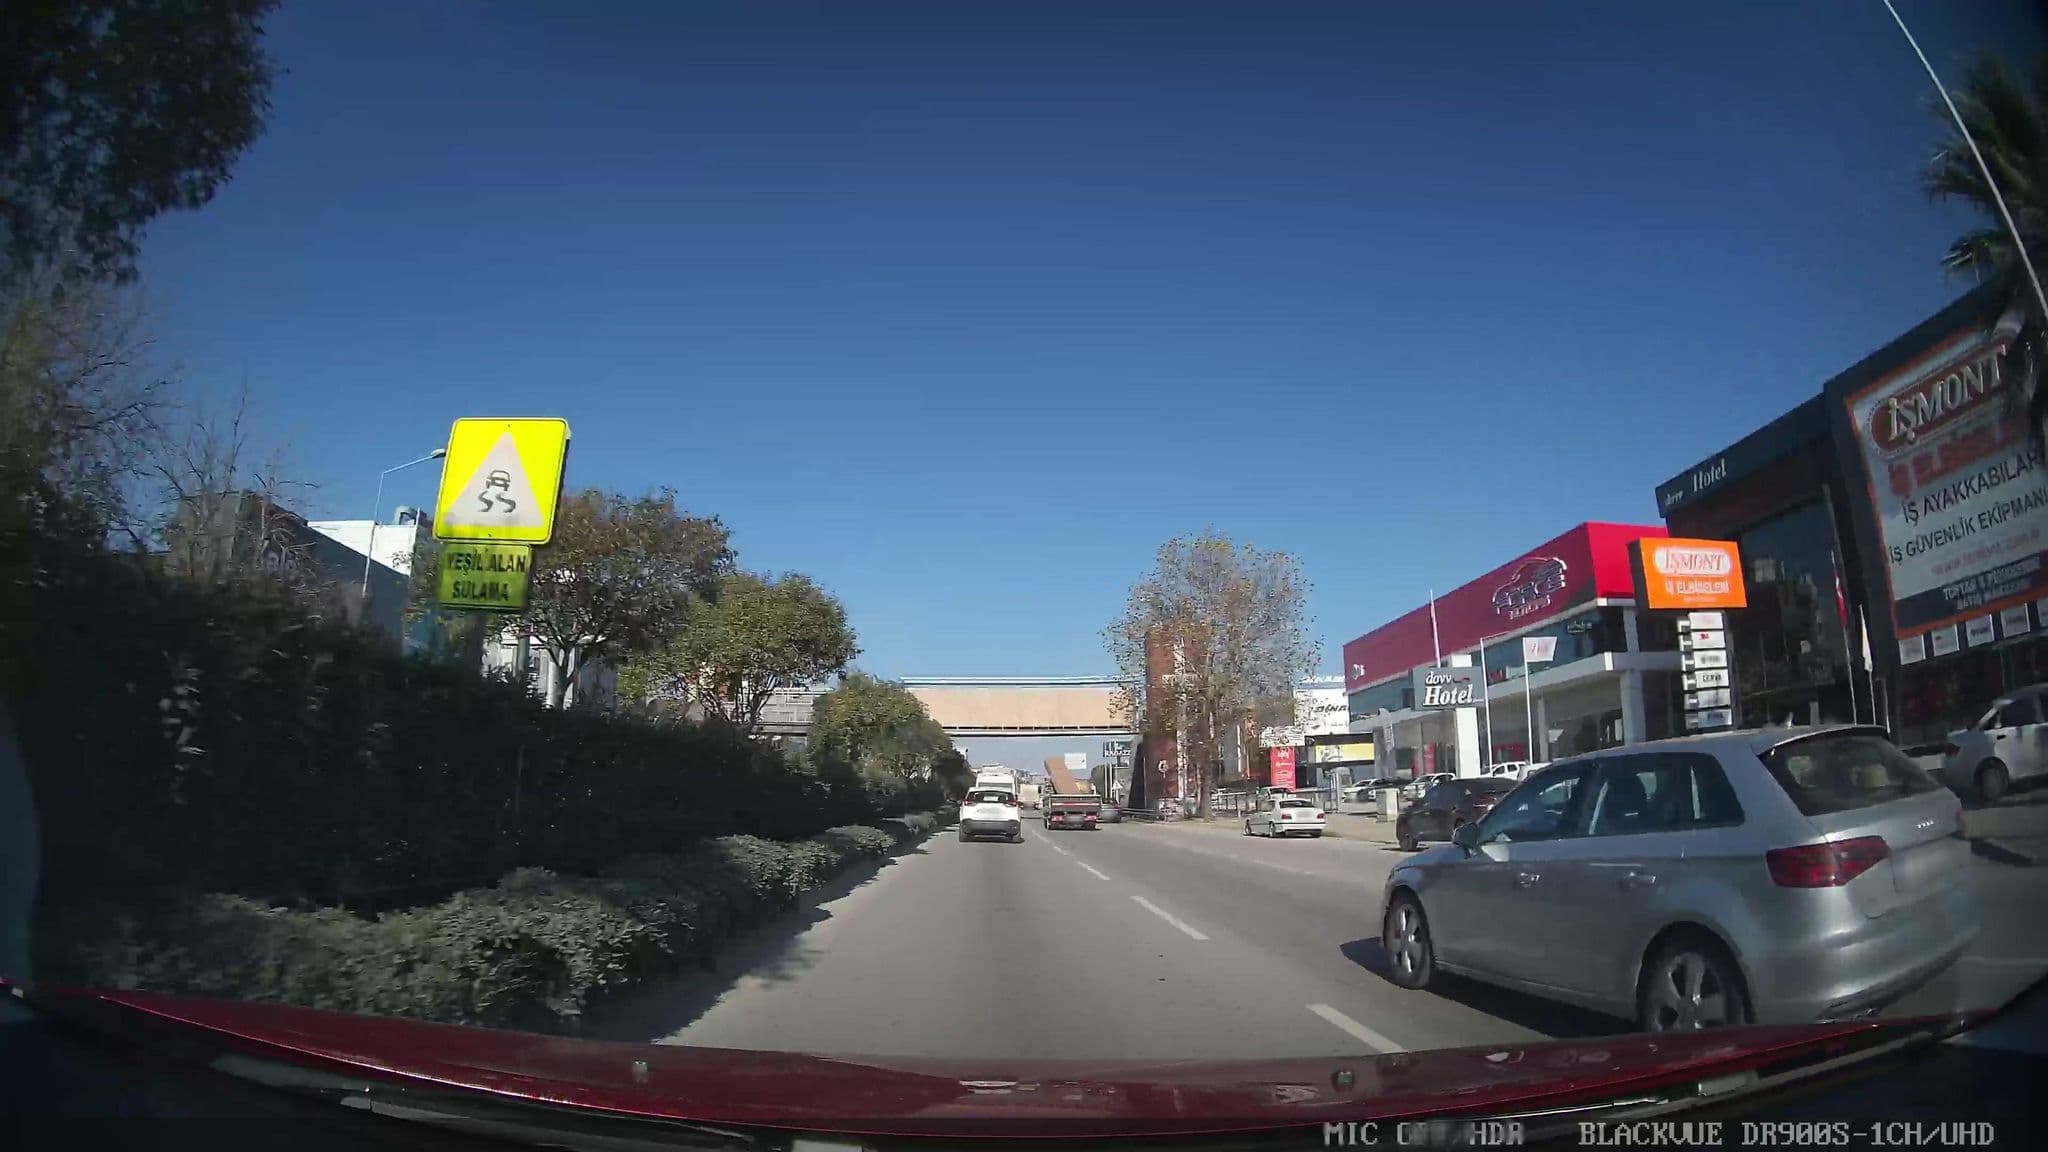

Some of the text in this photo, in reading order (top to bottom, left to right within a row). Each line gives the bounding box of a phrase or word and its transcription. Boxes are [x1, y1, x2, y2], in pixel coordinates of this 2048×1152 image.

[1692, 458, 1727, 492] Hotel
[1905, 514, 1977, 558] GÜVENLİK
[488, 552, 526, 572] ALAN
[452, 580, 509, 601] SULAMA
[1425, 671, 1452, 685] dovv
[1422, 684, 1473, 706] Hotel
